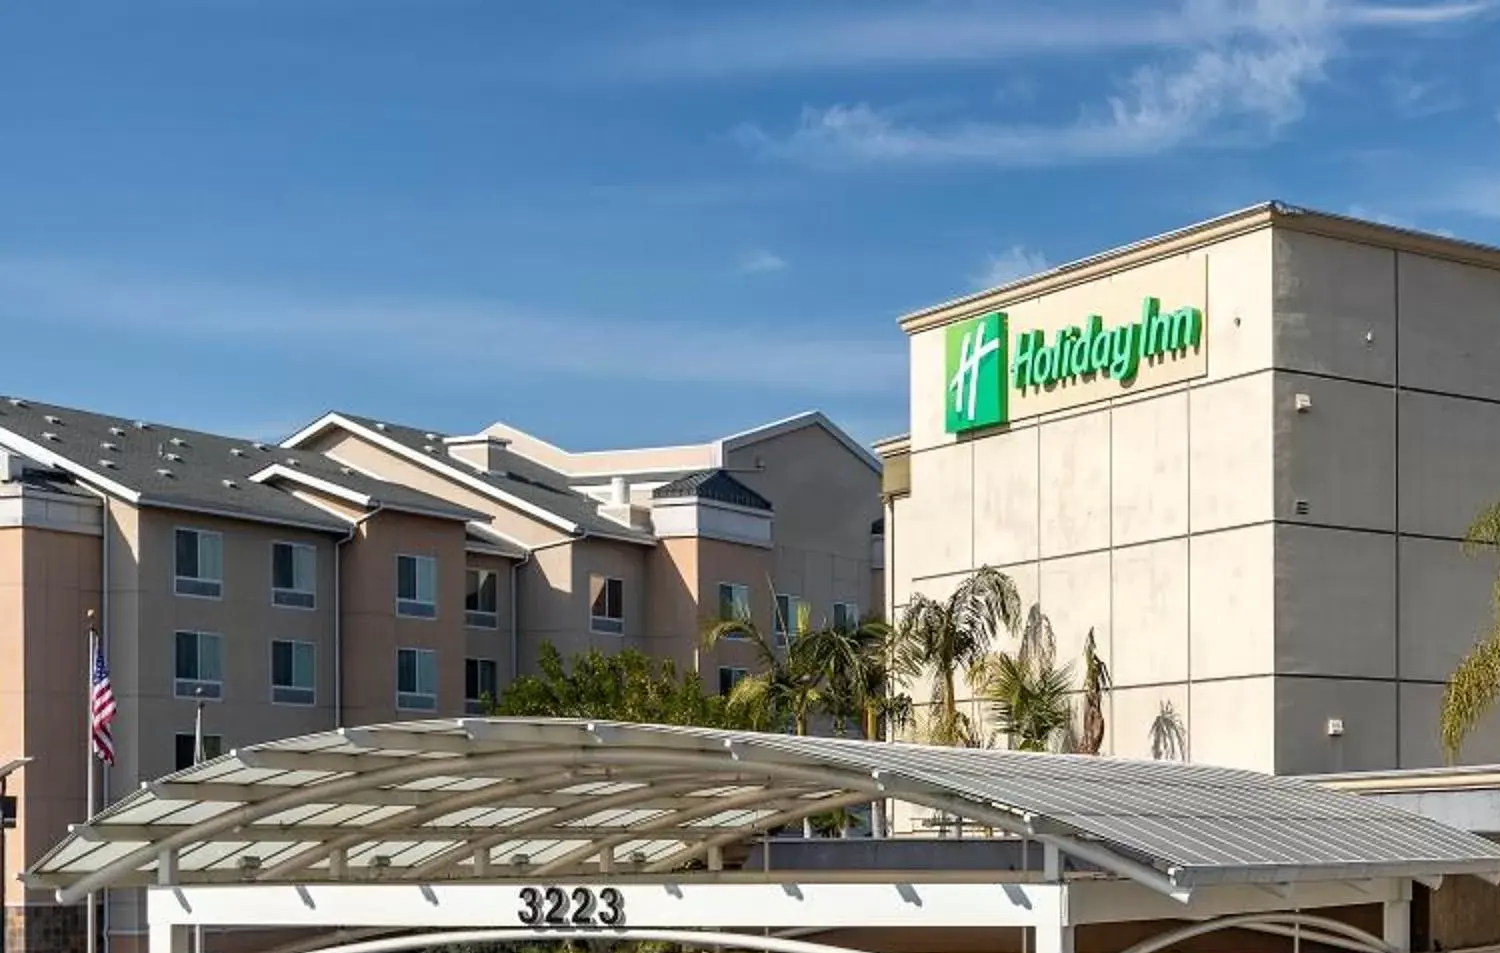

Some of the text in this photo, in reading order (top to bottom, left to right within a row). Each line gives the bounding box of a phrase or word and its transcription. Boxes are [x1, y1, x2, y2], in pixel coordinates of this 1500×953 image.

[1012, 296, 1202, 385] Holiday Inn
[518, 887, 626, 925] 3223
